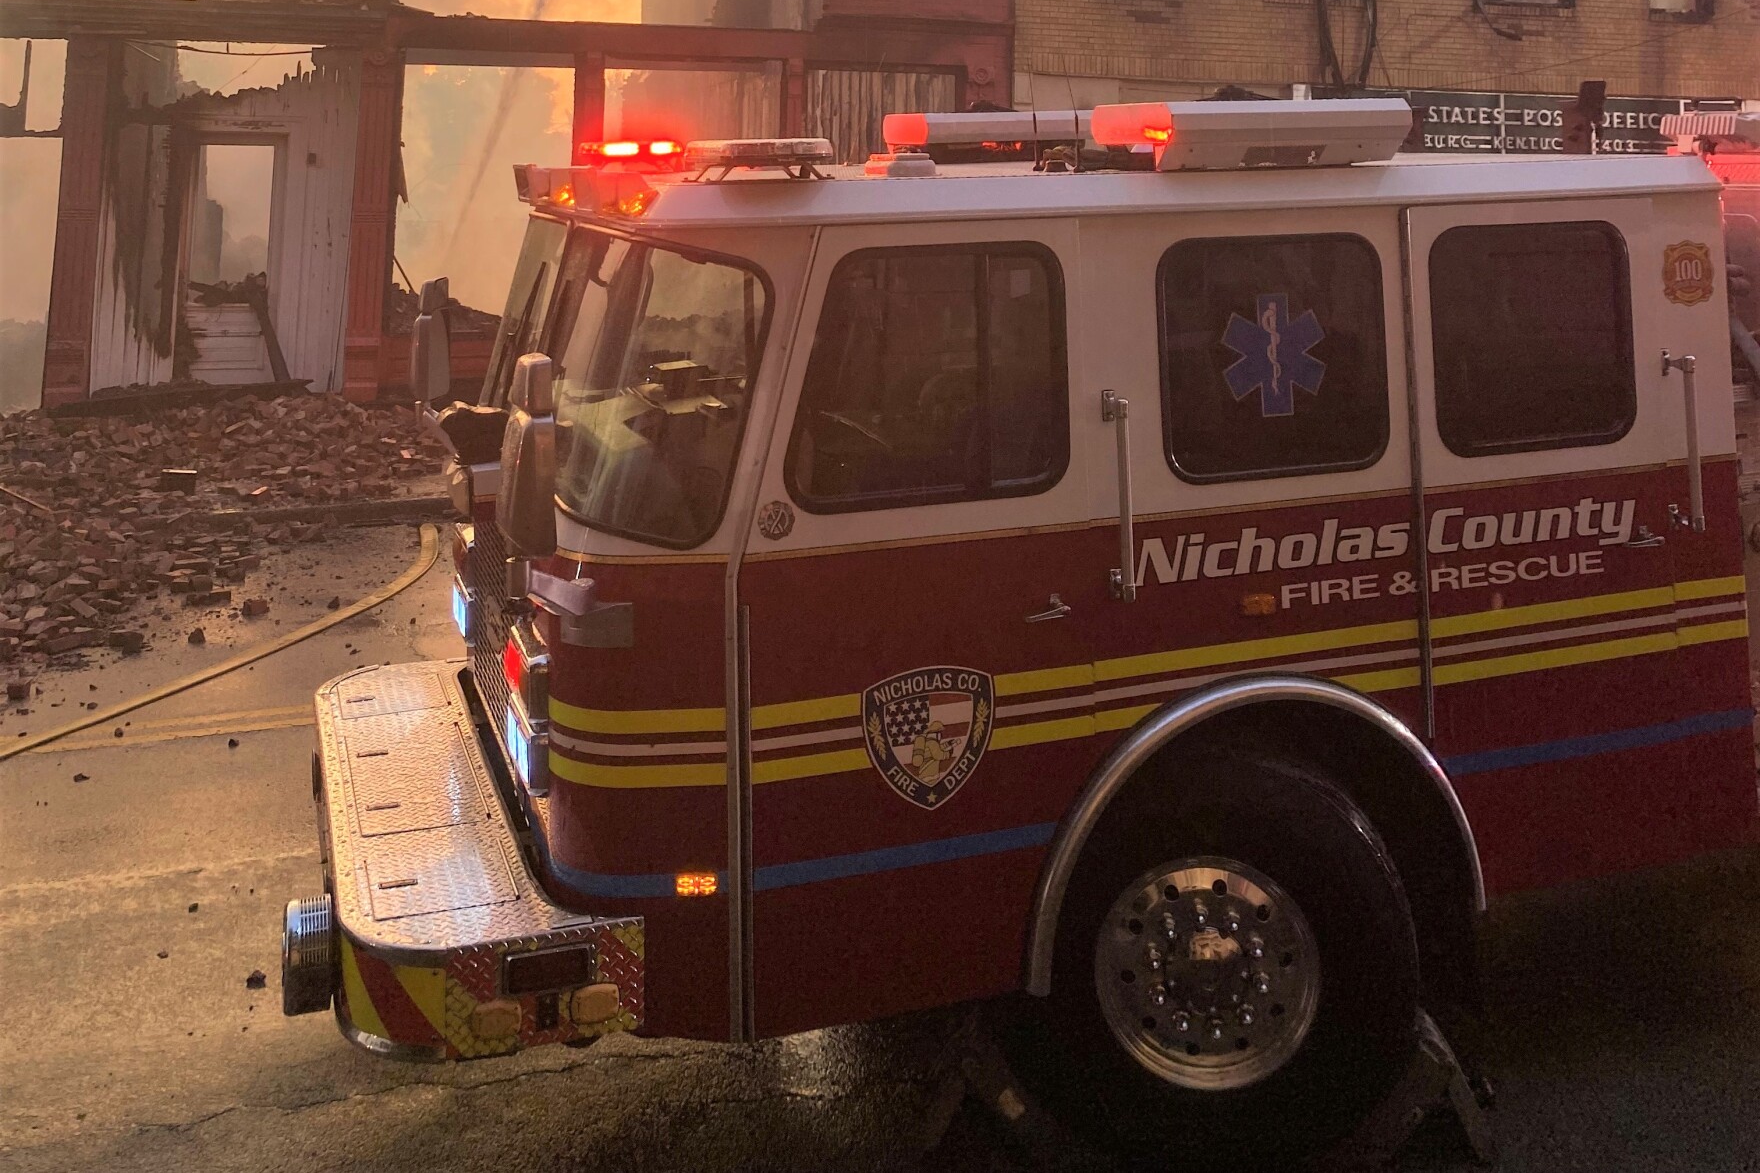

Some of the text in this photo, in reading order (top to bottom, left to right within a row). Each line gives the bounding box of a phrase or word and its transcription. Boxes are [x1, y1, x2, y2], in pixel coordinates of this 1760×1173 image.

[1428, 106, 1501, 125] STATES
[1523, 108, 1563, 126] POS
[1424, 134, 1471, 149] BURG
[1493, 136, 1564, 151] KENTUC
[1674, 259, 1702, 281] 100
[1134, 497, 1636, 587] Nicholas County
[1281, 550, 1605, 609] FIRE & RESCUE
[873, 673, 982, 706] NICHOLAS CO.
[887, 765, 920, 797] FIRE
[943, 750, 976, 791] DEPT
